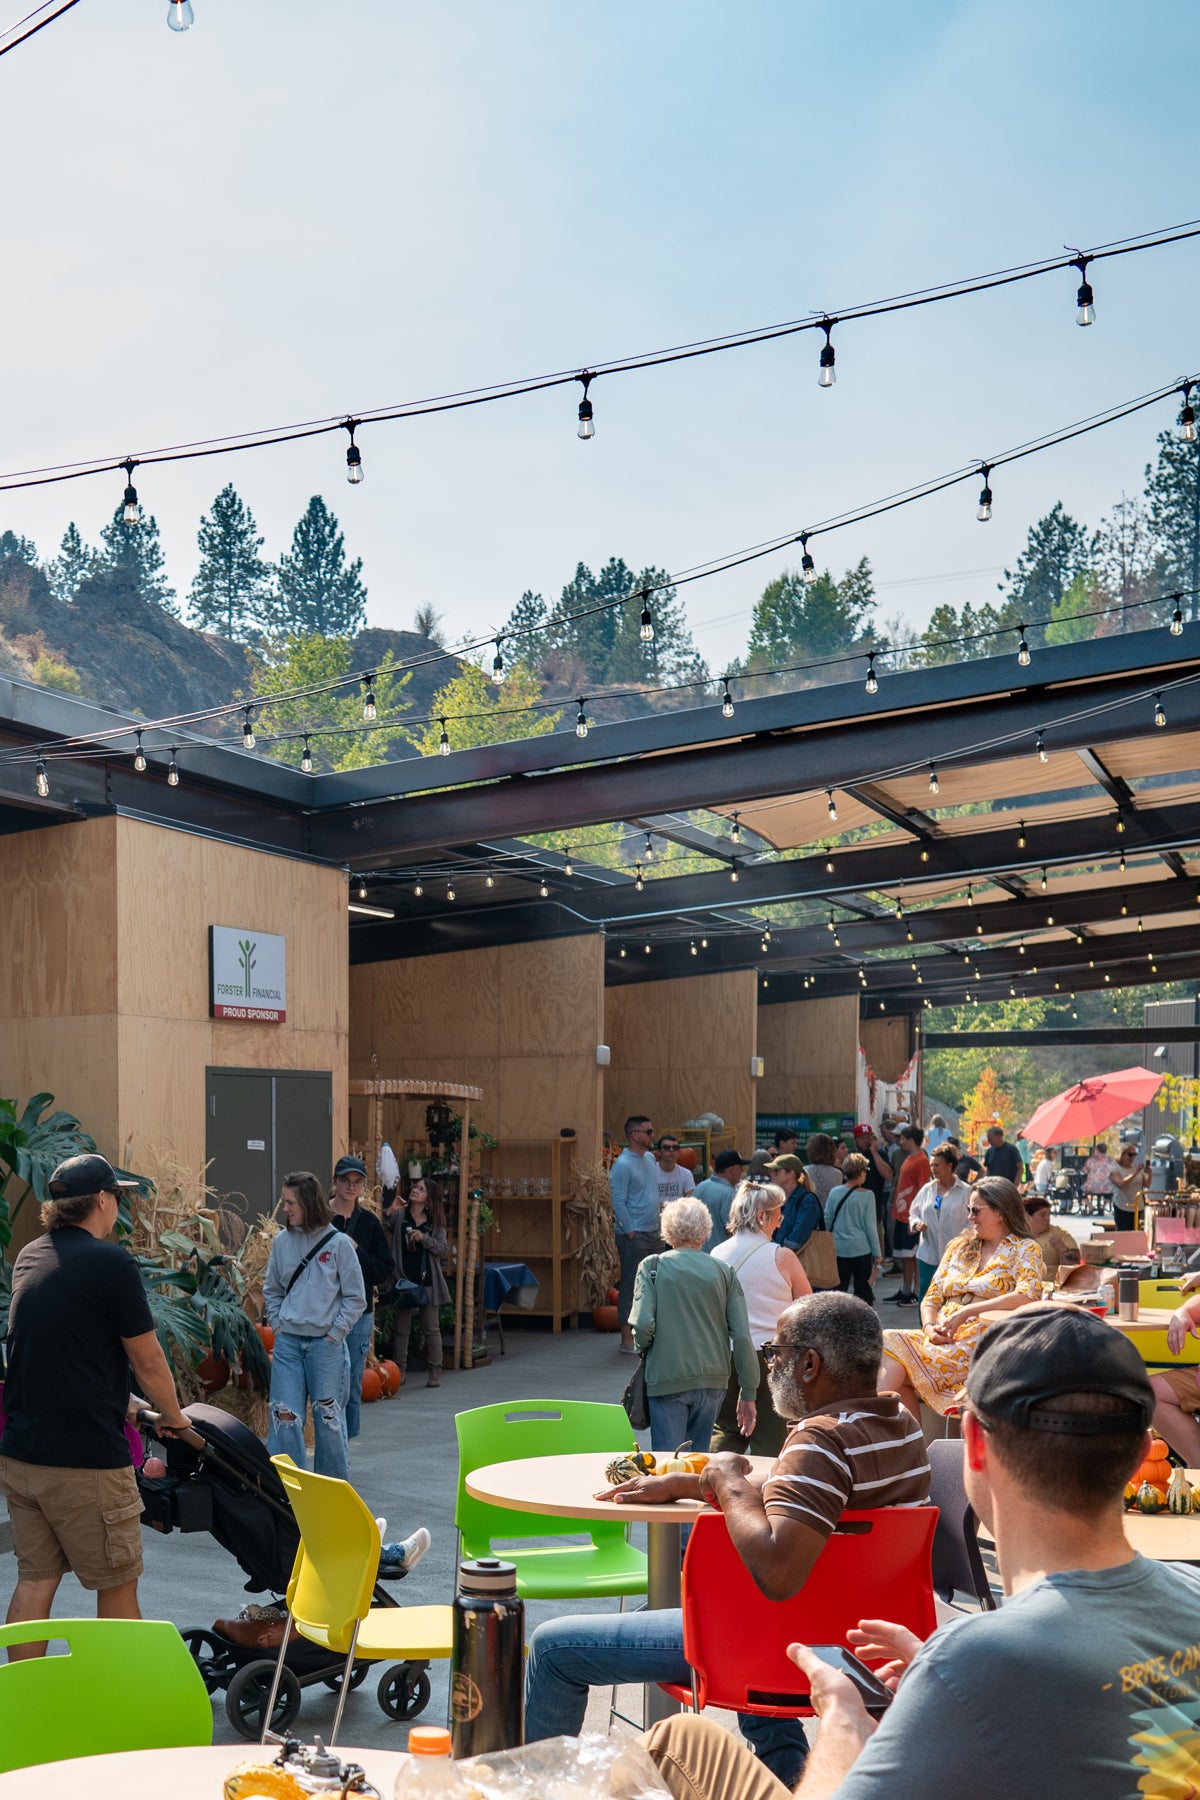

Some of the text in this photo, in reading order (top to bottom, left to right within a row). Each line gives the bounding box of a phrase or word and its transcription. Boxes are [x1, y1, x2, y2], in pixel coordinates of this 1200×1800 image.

[217, 983, 282, 1001] FORSTER FINANCIAL
[222, 1006, 279, 1021] PROUD SPONSOR
[1118, 1655, 1171, 1693] BRYCE
